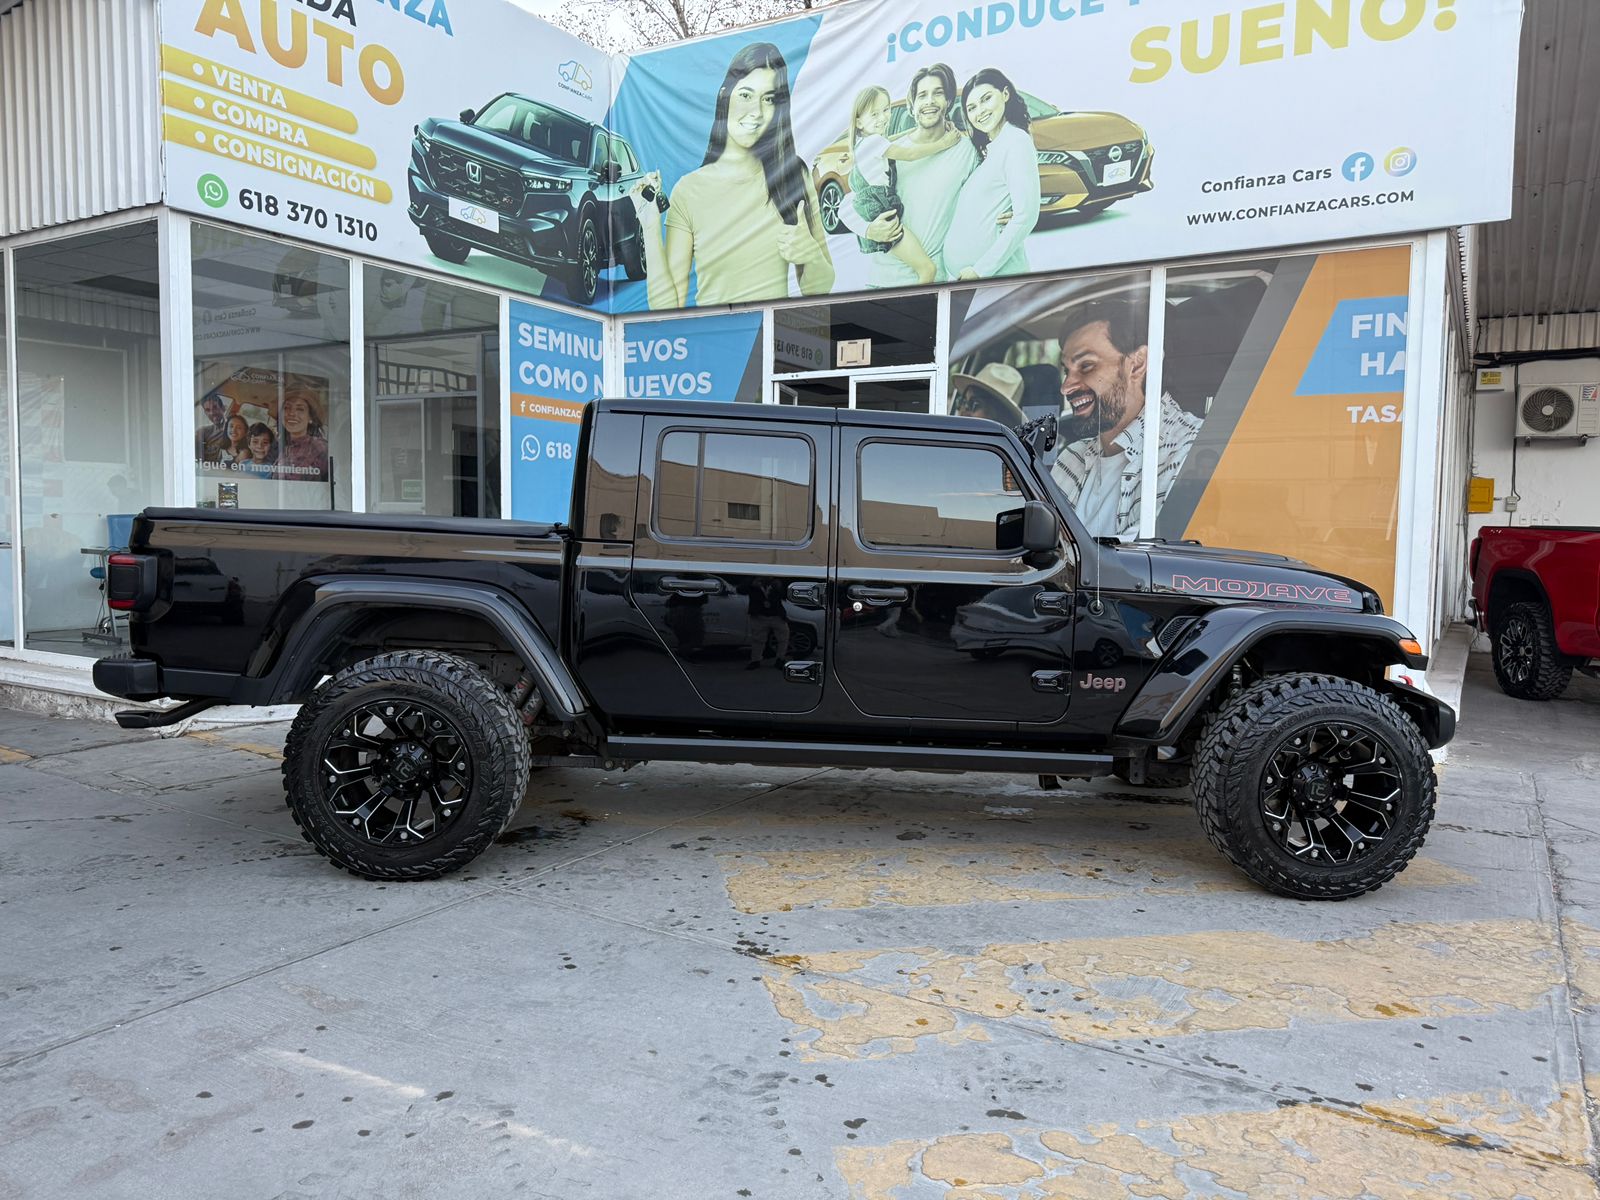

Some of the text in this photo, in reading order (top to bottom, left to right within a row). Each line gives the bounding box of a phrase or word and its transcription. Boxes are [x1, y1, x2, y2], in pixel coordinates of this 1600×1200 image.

[194, 0, 404, 106] AUTO
[211, 65, 287, 109] VENTA
[212, 101, 309, 147] COMPRA
[213, 134, 375, 199] CONSIGNACIÓN
[1201, 166, 1332, 194] Confianza Cars
[239, 188, 378, 242] 618 370 1310
[1186, 190, 1415, 226] WWW.CONFIANZACARS.COM
[1351, 311, 1408, 339] FIN
[518, 360, 588, 393] COMO
[545, 441, 572, 460] 618
[231, 463, 246, 472] en
[251, 463, 321, 476] movimiento
[1172, 575, 1352, 604] MOJAVE
[1079, 673, 1127, 693] Jeep
